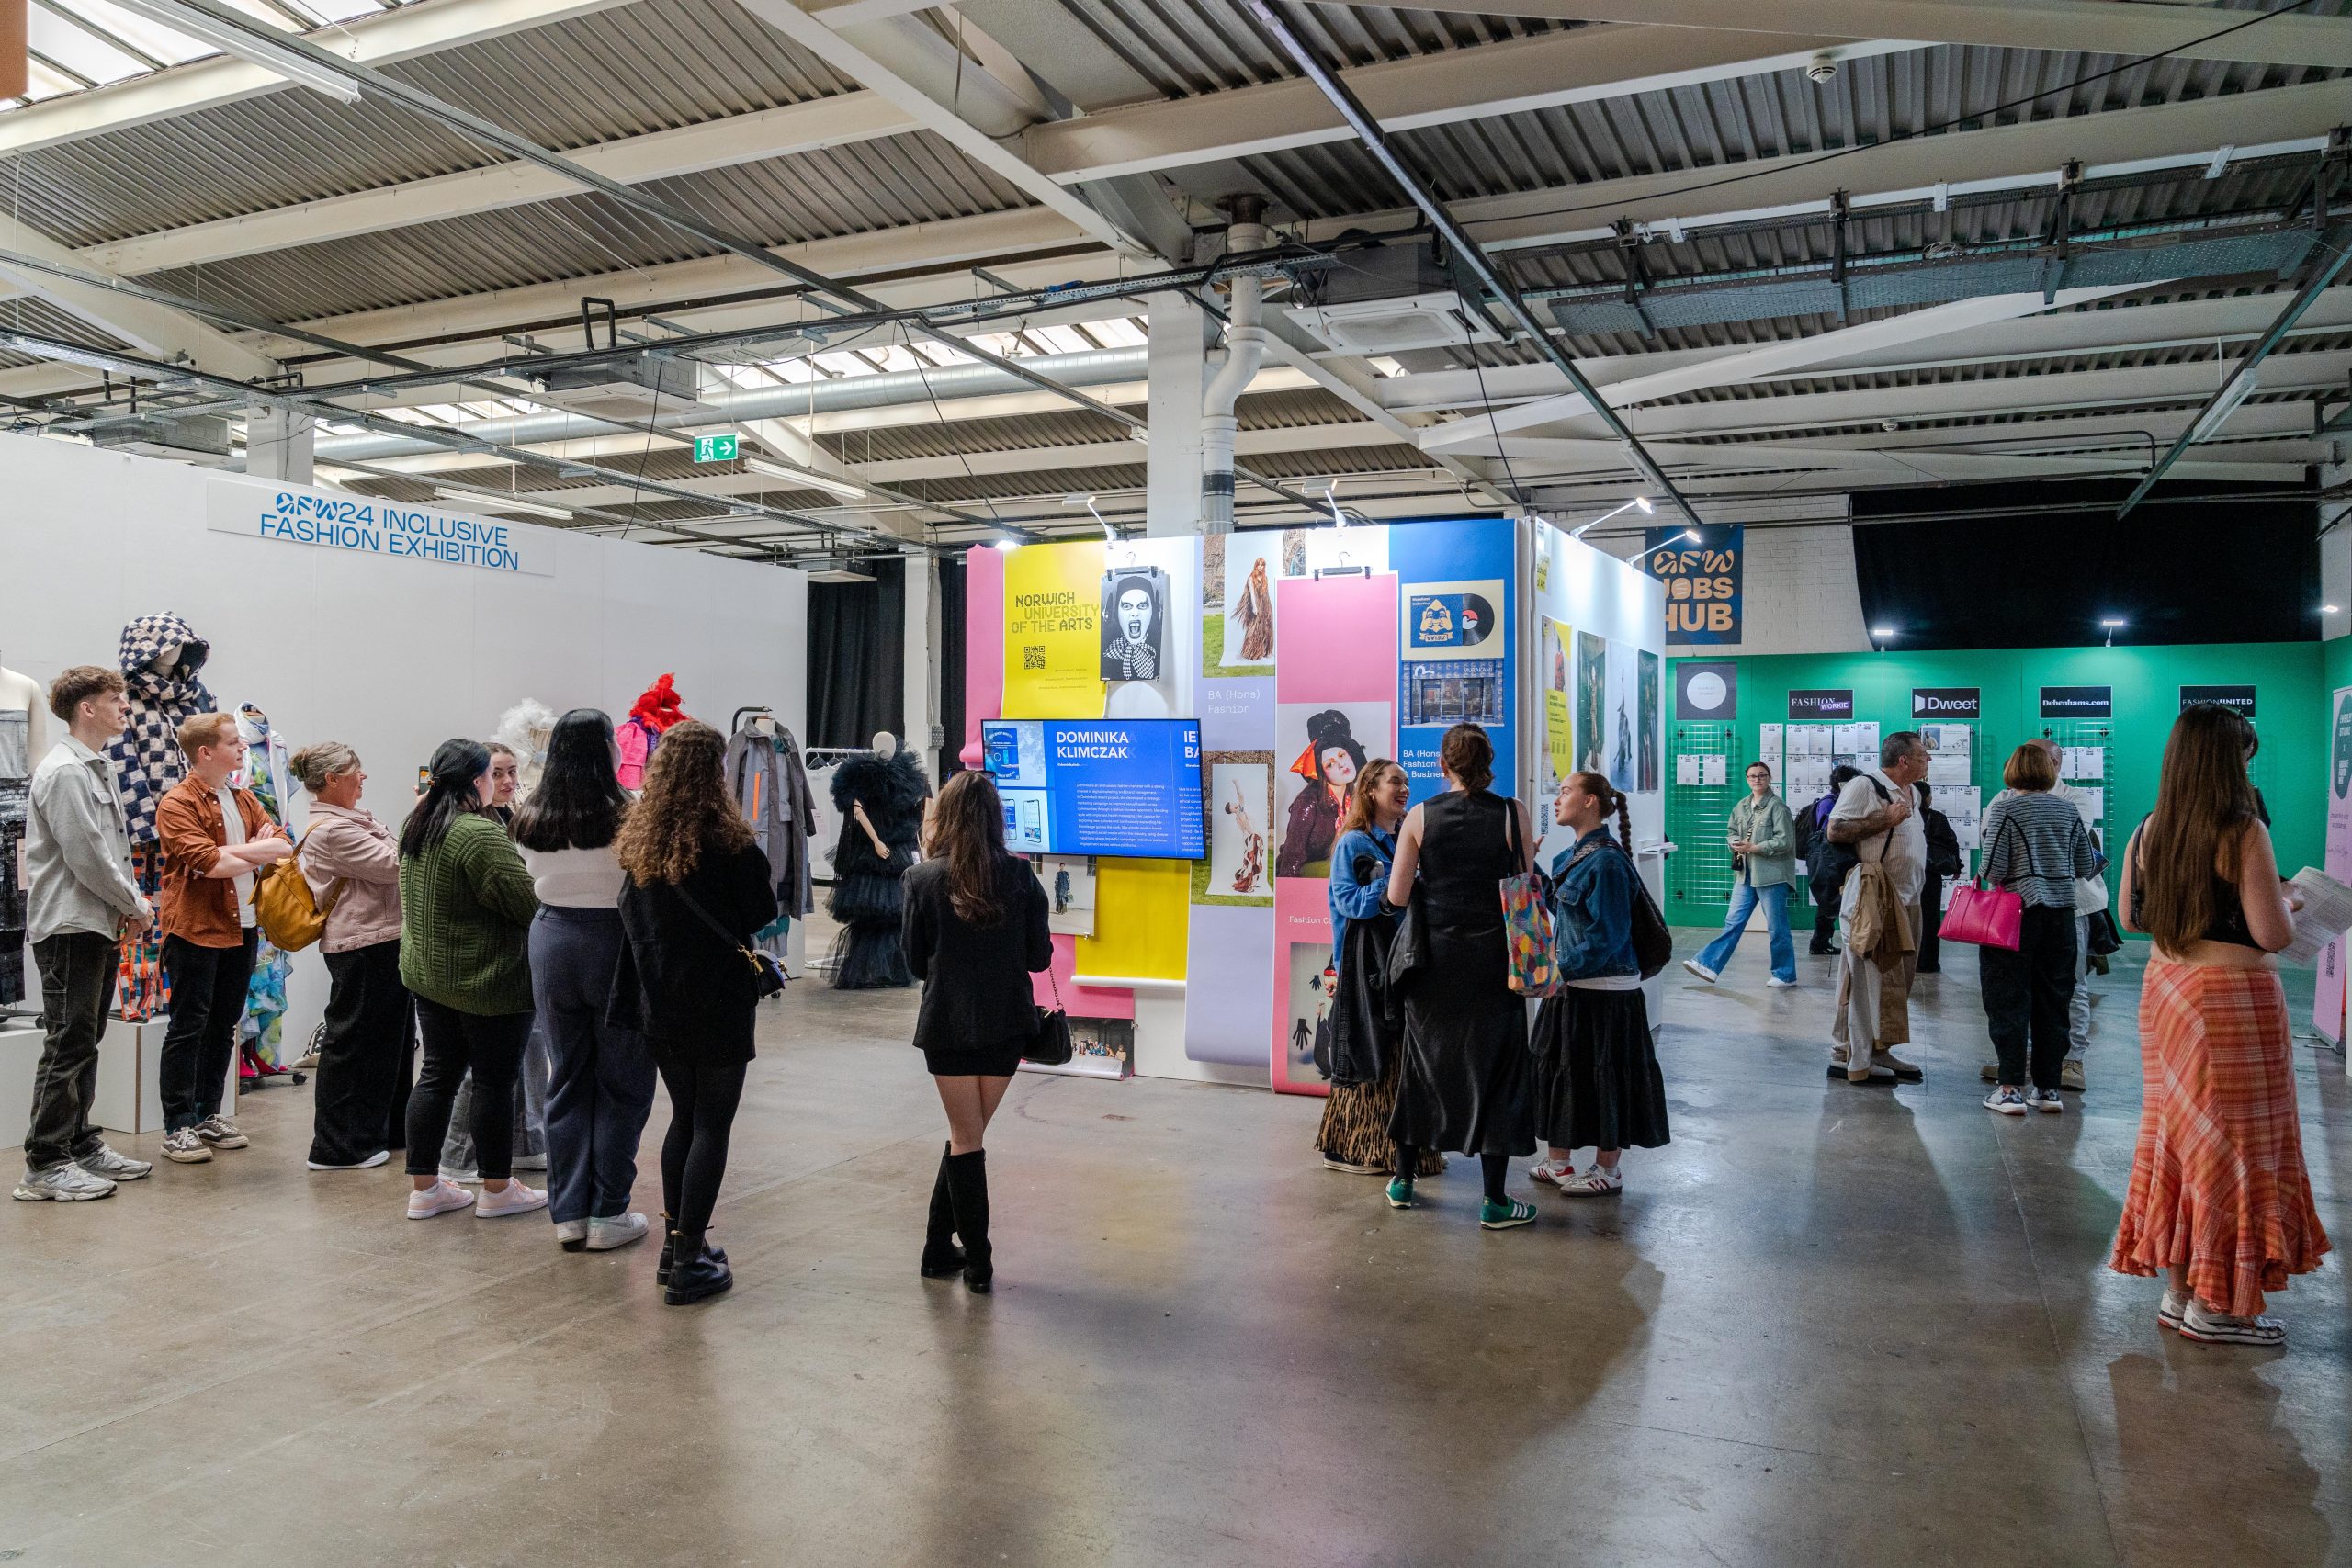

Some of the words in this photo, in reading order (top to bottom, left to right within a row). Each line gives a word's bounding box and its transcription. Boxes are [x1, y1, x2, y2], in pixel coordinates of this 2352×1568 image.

[276, 492, 374, 526] GFW24
[383, 509, 508, 547] INCLUSIVE
[261, 513, 379, 551] FASHION
[389, 533, 518, 570] EXHIBITION
[1654, 549, 1735, 574] GFW
[1015, 592, 1075, 607] NORWICH
[1024, 604, 1100, 620] UNIVERSITY
[1011, 621, 1028, 634] OF
[1031, 619, 1056, 633] THE
[1059, 617, 1093, 632] ARTS
[1208, 690, 1222, 700] BA
[1226, 689, 1261, 701] (Hons)
[1792, 697, 1836, 707] FASHION
[1820, 702, 1849, 710] WORKIE
[1928, 697, 1977, 710] Dweet
[1208, 704, 1250, 714] Fashion
[1056, 731, 1129, 743] DOMINIKA
[1183, 730, 1199, 743] IE
[1057, 746, 1129, 759] KLIMCZAK
[1403, 750, 1415, 758] BA
[1417, 750, 1441, 759] (Hons
[1403, 760, 1437, 768] Fashion
[1411, 770, 1445, 779] Busines
[1289, 915, 1321, 924] Fashion
